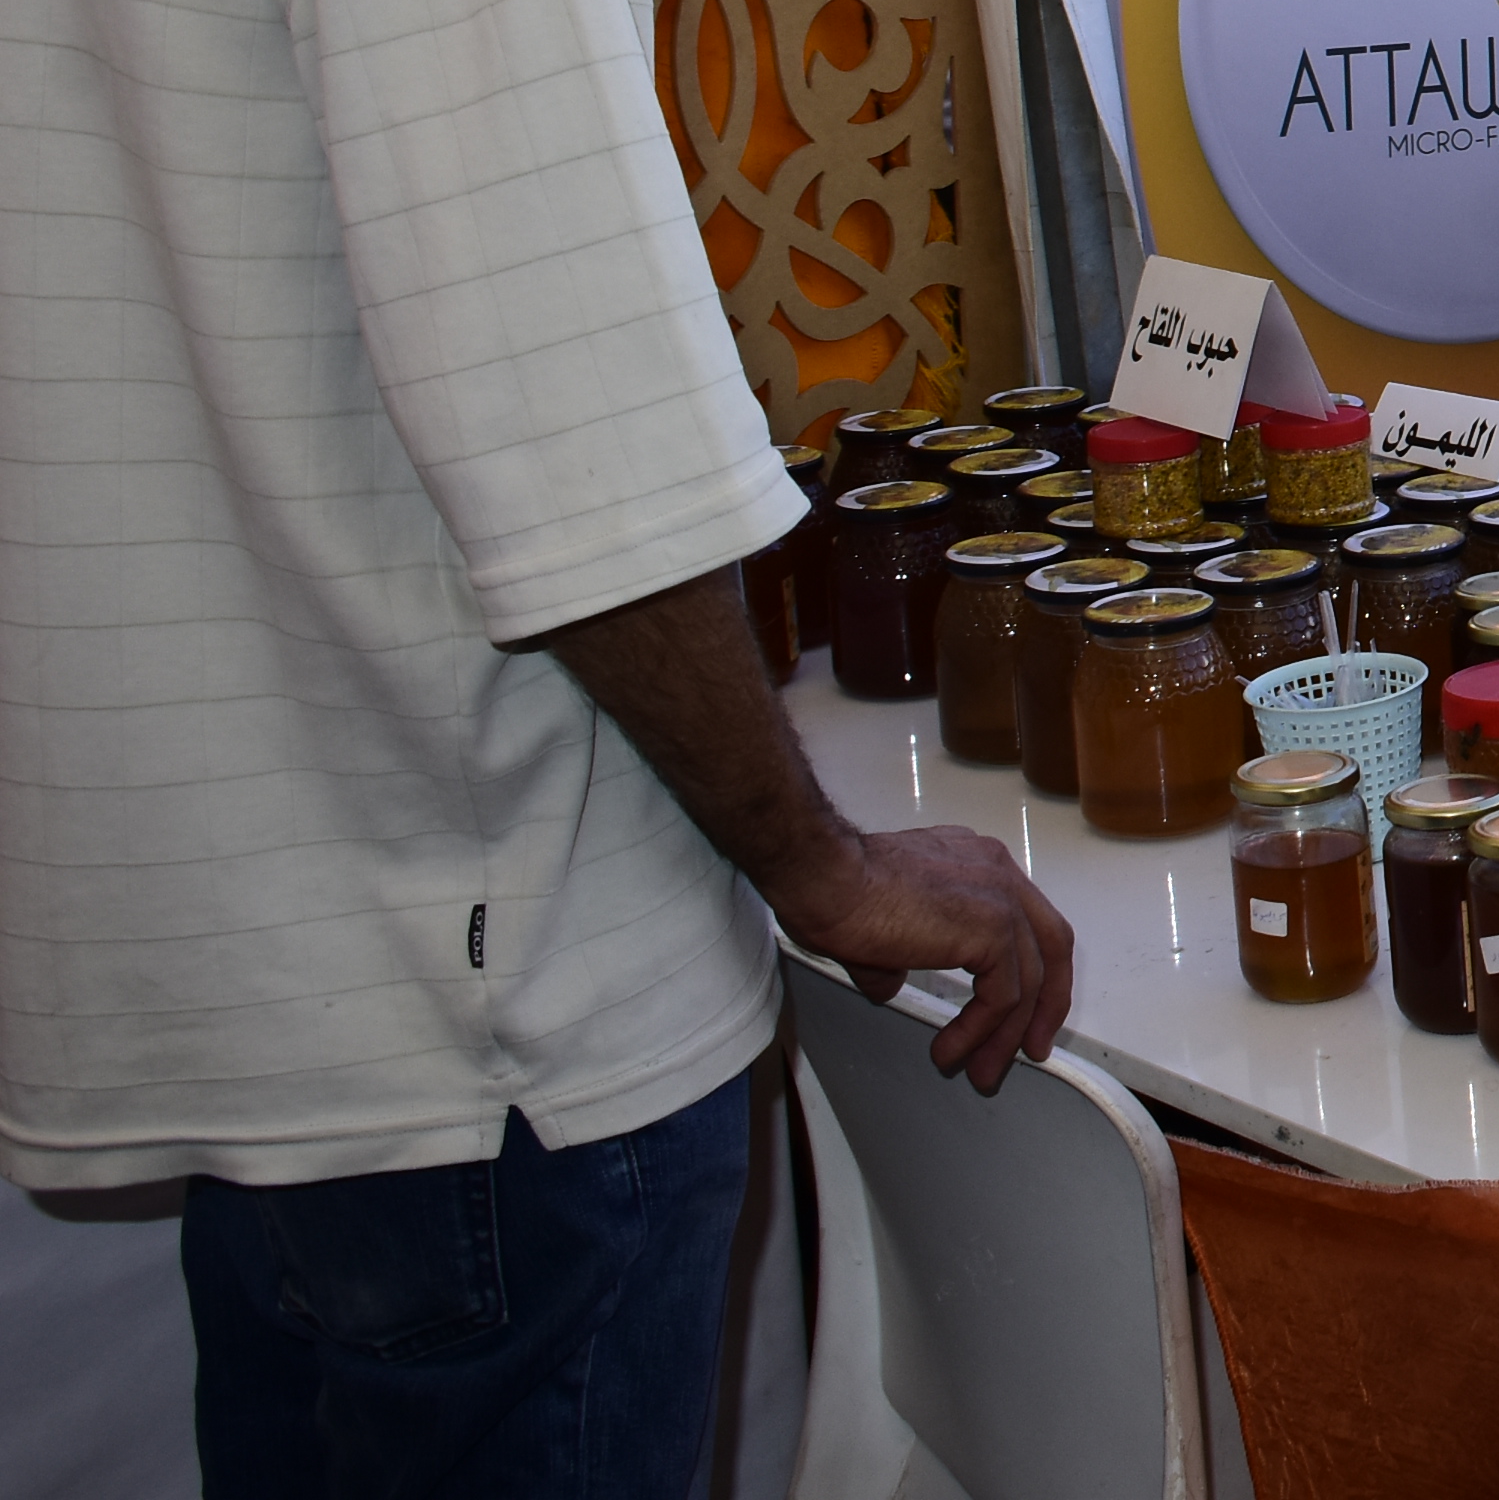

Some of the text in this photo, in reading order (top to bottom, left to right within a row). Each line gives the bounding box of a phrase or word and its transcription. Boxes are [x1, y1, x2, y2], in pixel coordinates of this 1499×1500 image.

[1131, 303, 1239, 378] حبوب اللقاح
[1381, 409, 1498, 468] الليمون
[474, 911, 484, 962] POLO
